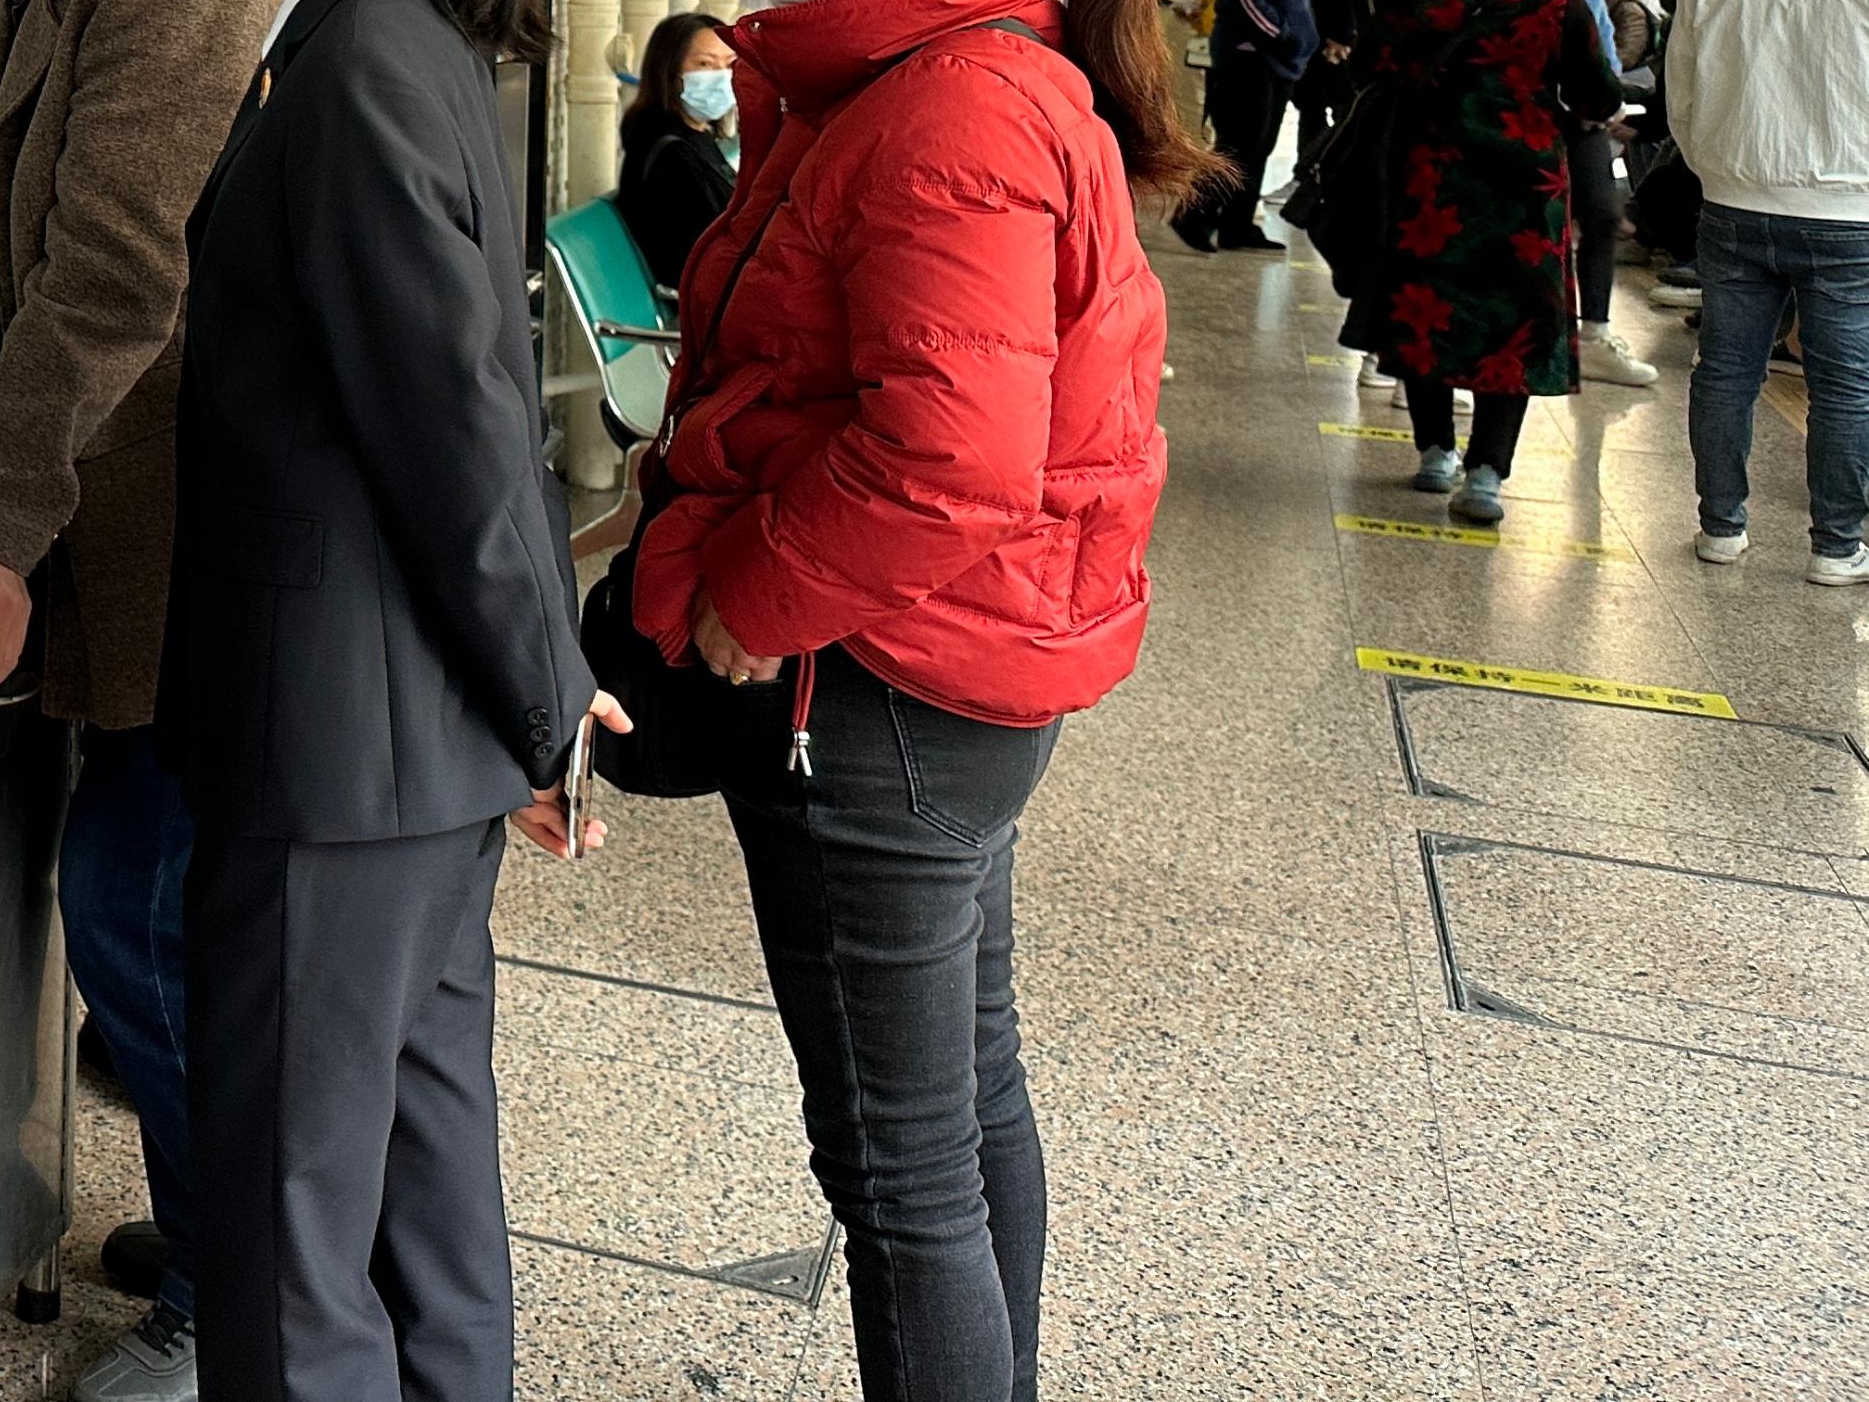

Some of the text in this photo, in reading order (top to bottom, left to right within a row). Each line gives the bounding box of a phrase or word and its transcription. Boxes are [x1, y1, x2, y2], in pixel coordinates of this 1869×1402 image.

[1384, 654, 1706, 710] 请保持一米距离
